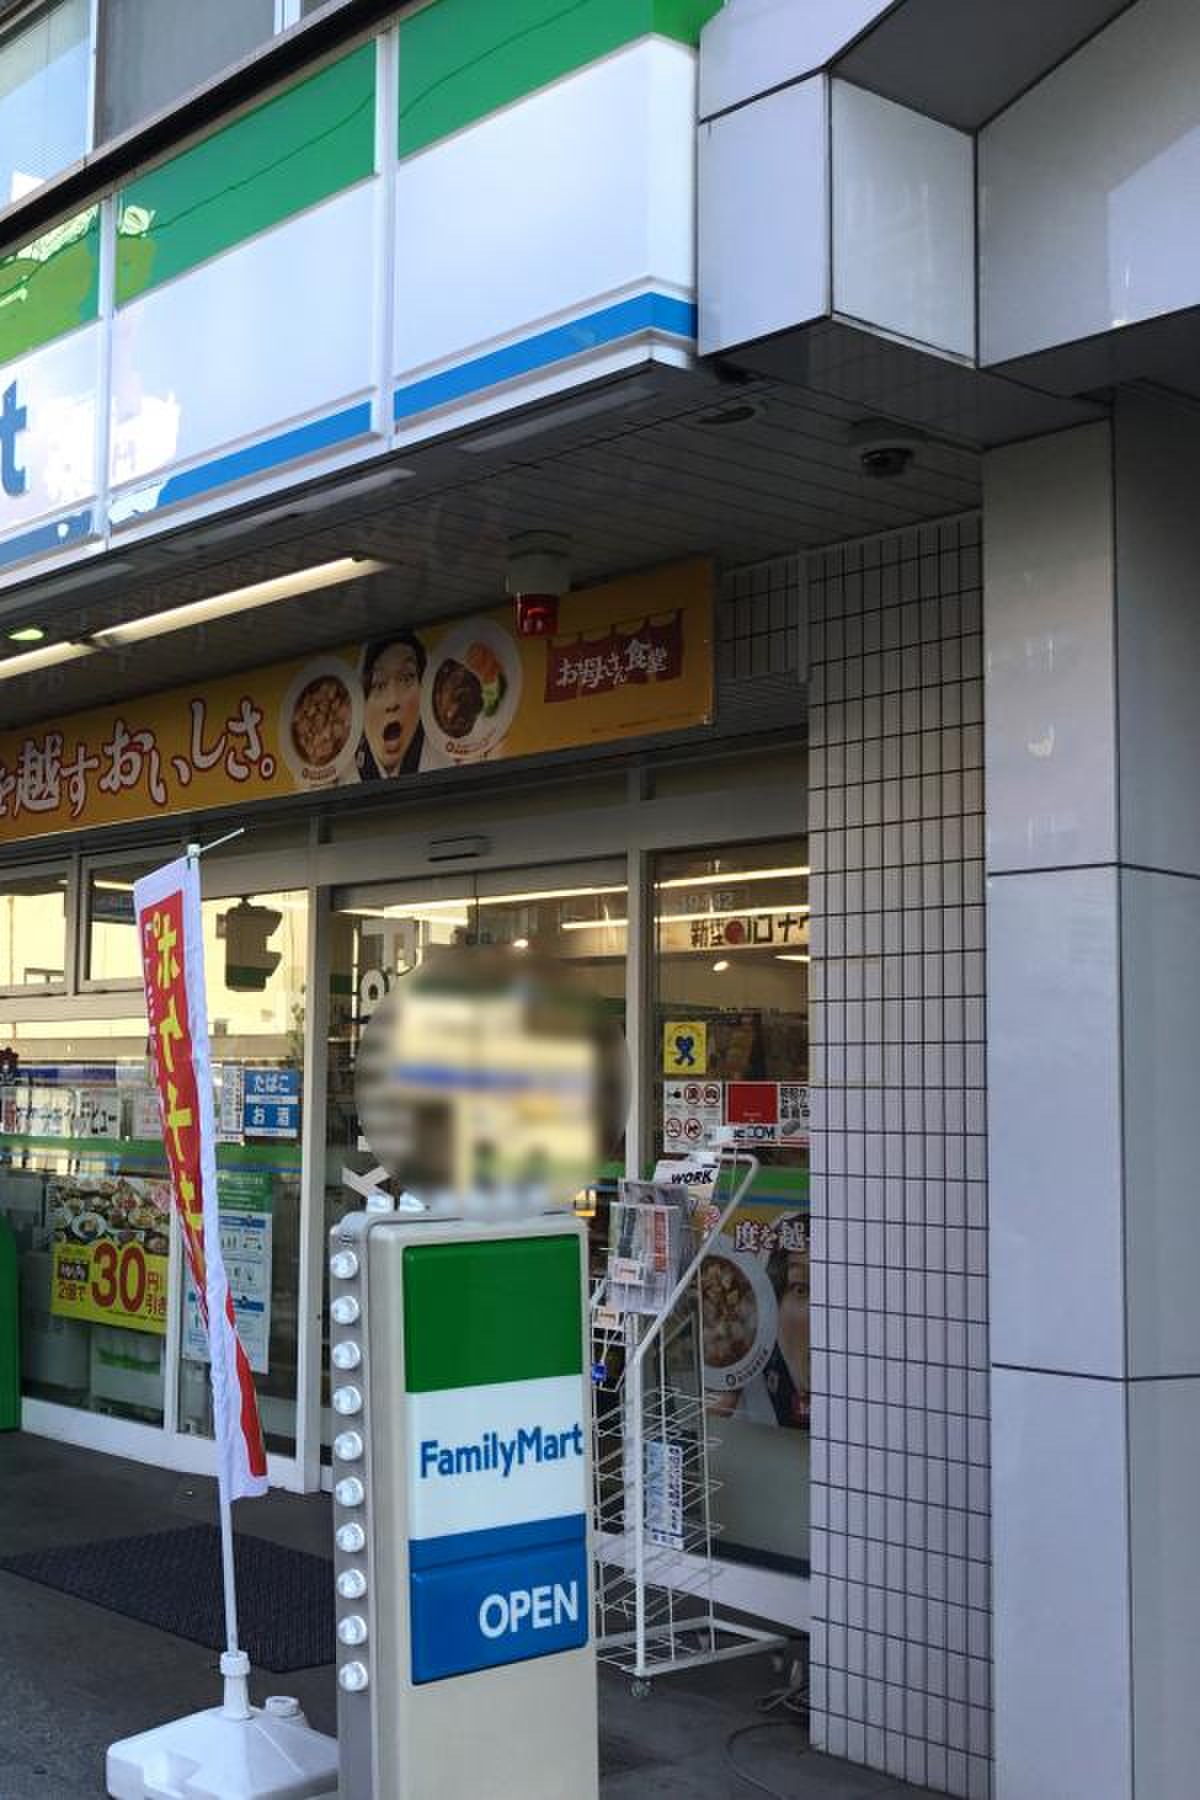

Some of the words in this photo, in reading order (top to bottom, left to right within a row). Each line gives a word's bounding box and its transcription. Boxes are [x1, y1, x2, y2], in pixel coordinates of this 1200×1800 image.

[556, 639, 669, 688] お母さん食堂
[672, 1169, 713, 1184] WORK
[735, 1219, 810, 1251] 度を越
[92, 1242, 146, 1313] 30
[420, 1422, 585, 1479] FamilyMart
[478, 1580, 580, 1640] OPEN
